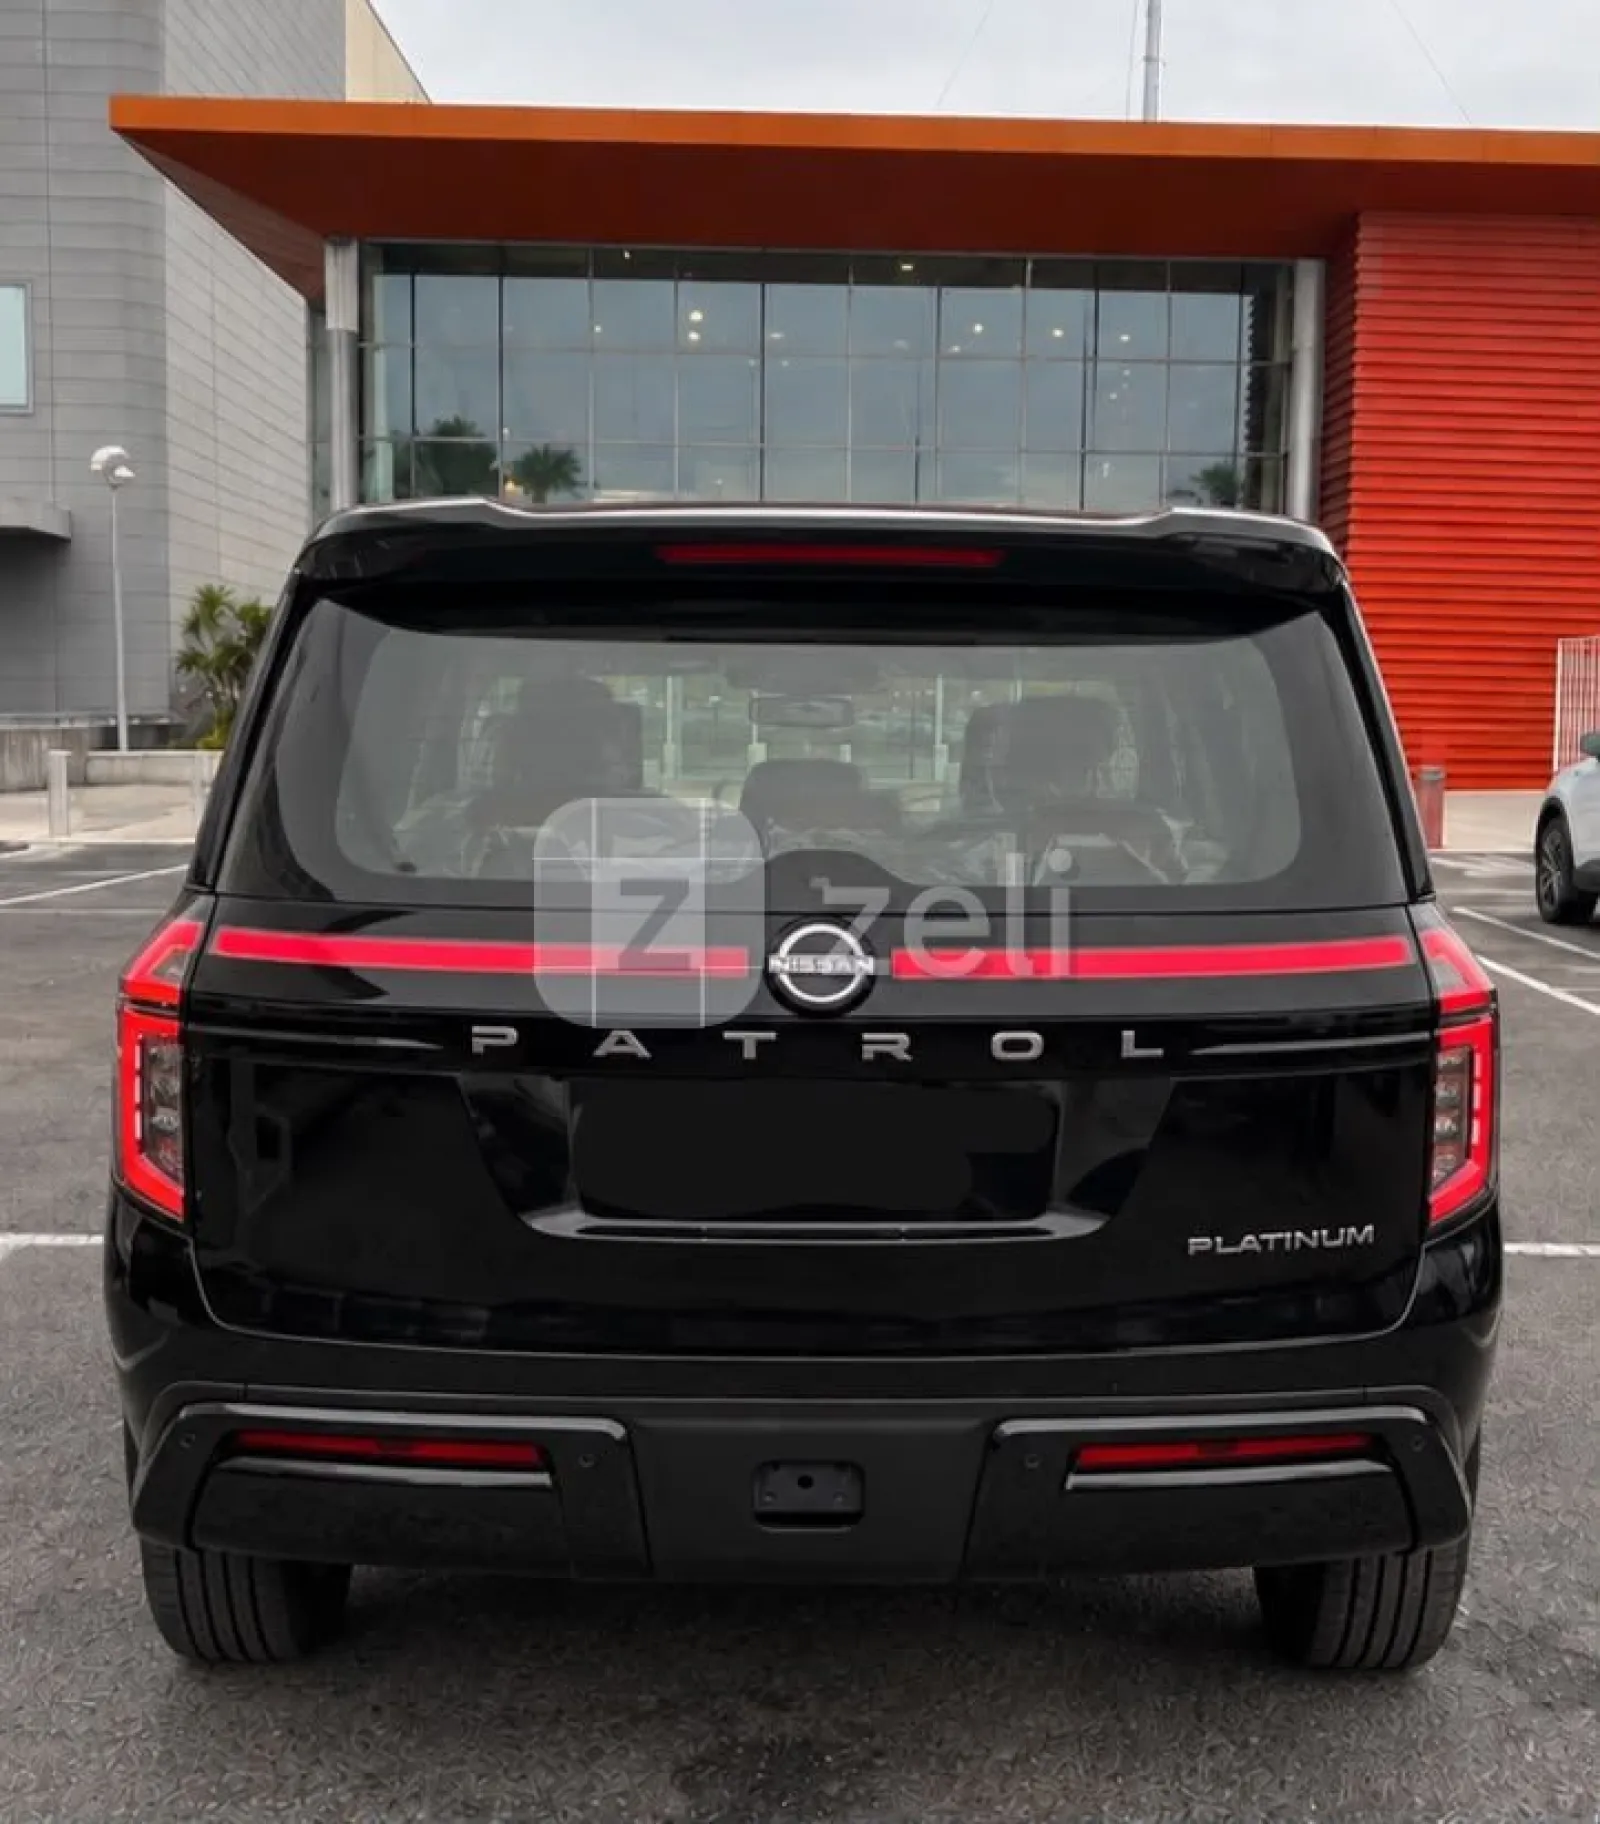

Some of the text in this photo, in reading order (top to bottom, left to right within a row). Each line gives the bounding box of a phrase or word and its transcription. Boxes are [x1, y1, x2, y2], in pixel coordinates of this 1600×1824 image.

[769, 955, 873, 974] NISSAN
[471, 1026, 1164, 1060] PATROL
[1188, 1224, 1375, 1255] PLATINUM
